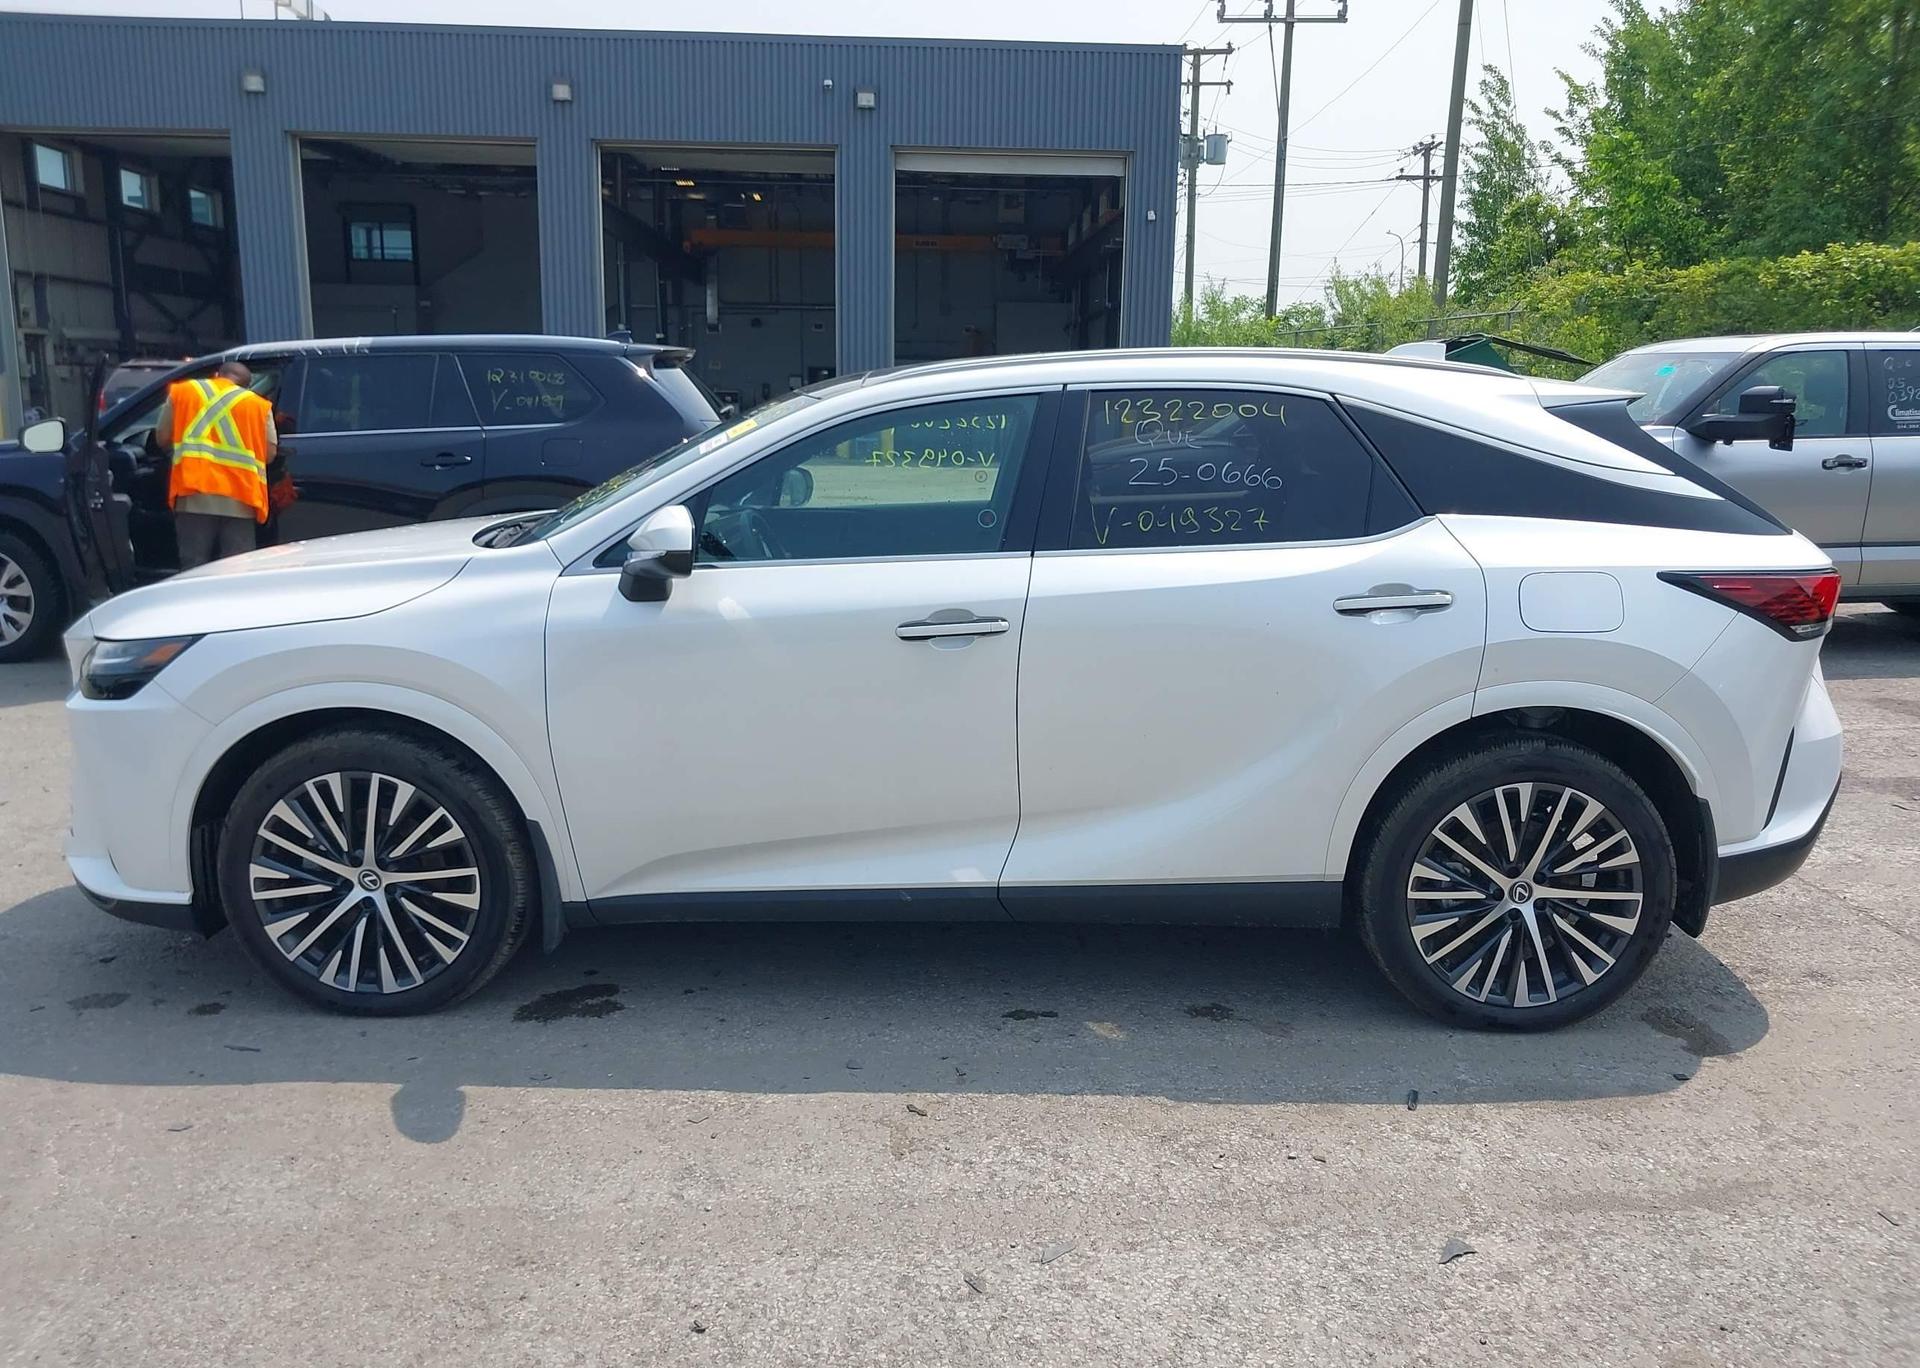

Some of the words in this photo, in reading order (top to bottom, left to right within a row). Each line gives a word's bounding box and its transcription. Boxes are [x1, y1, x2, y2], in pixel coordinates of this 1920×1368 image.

[1104, 399, 1286, 426] 12322004
[1135, 419, 1202, 449] QUE
[1128, 457, 1283, 490] 25-0666
